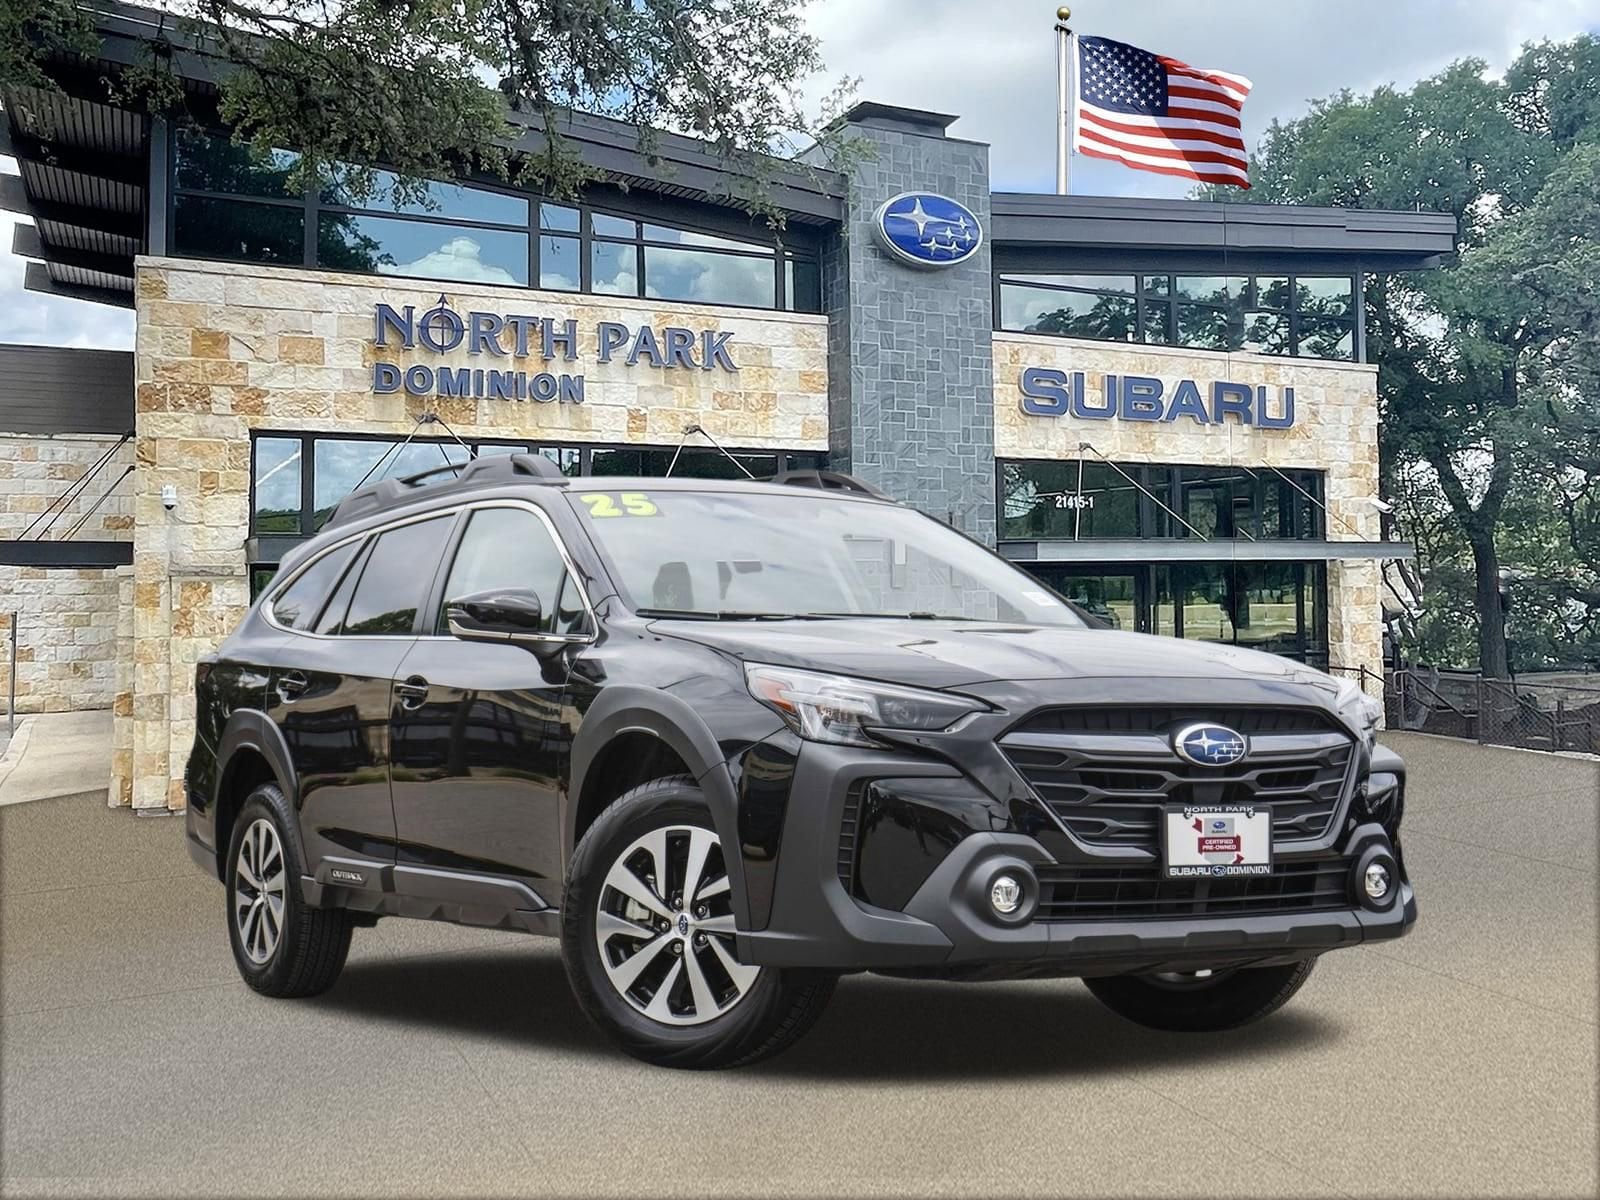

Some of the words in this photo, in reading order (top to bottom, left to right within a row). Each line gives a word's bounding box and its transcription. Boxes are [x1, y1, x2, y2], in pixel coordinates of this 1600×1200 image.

[374, 292, 579, 361] NORTH
[597, 320, 742, 373] PARK
[373, 361, 585, 404] DOMINION
[1019, 367, 1295, 429] SUBARU
[580, 493, 658, 517] 25
[332, 869, 362, 881] OUTBACK
[1169, 867, 1211, 876] SUBARU
[1227, 865, 1270, 875] DOMINION
